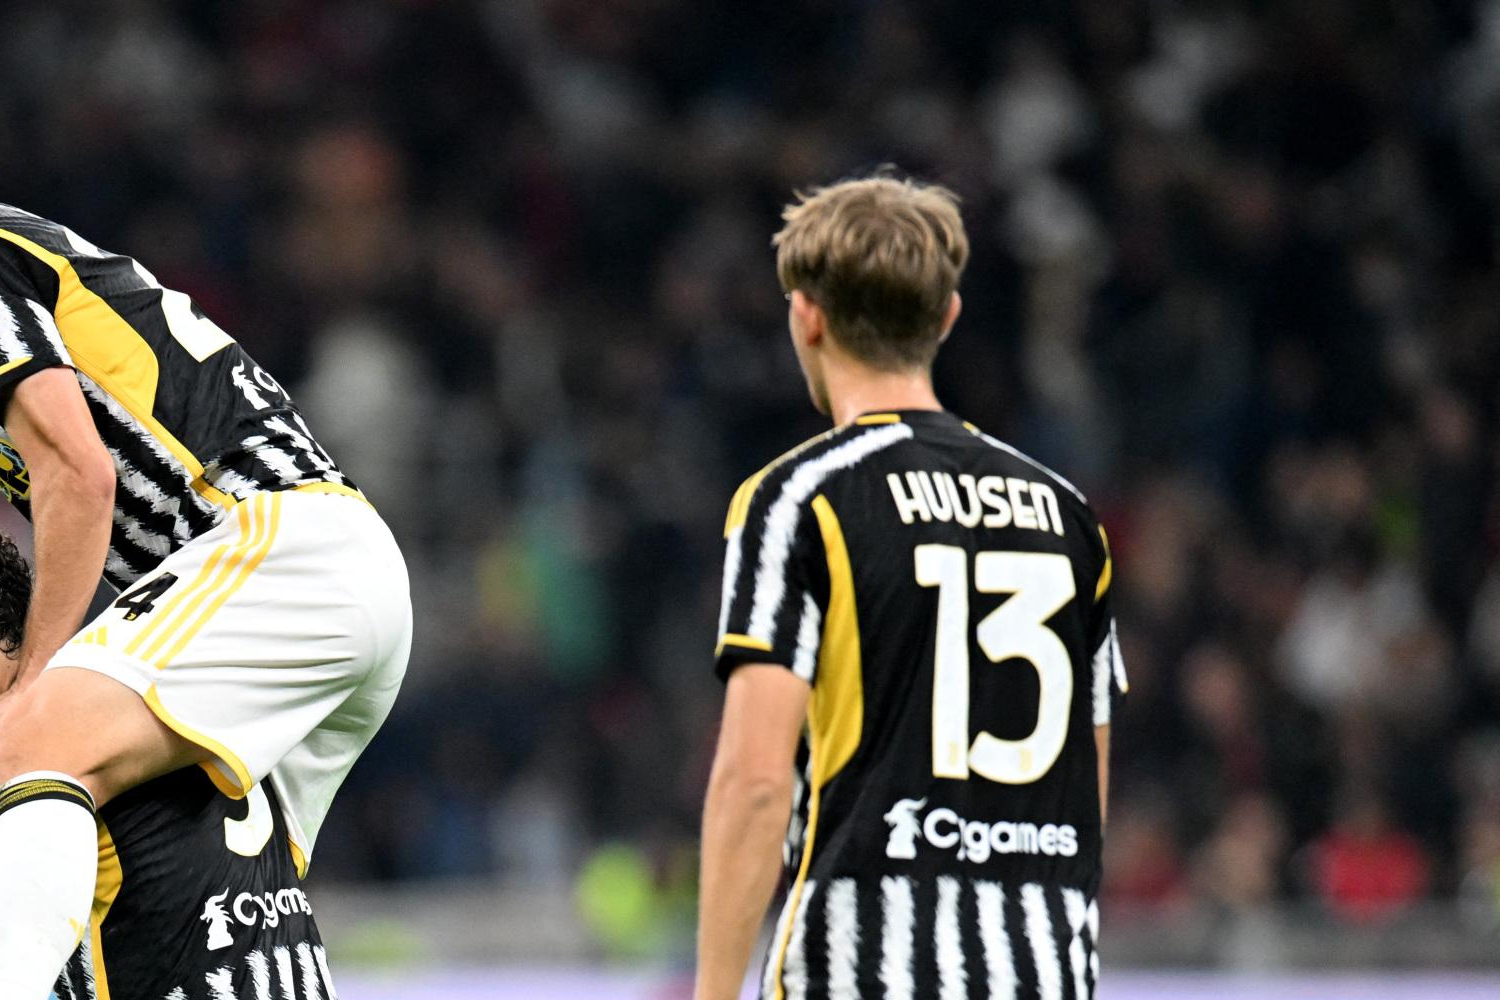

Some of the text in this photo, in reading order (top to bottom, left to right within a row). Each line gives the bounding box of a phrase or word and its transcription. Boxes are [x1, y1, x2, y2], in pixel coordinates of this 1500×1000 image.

[113, 571, 179, 621] 4
[913, 543, 1077, 785] 13
[923, 807, 1079, 864] Cygames
